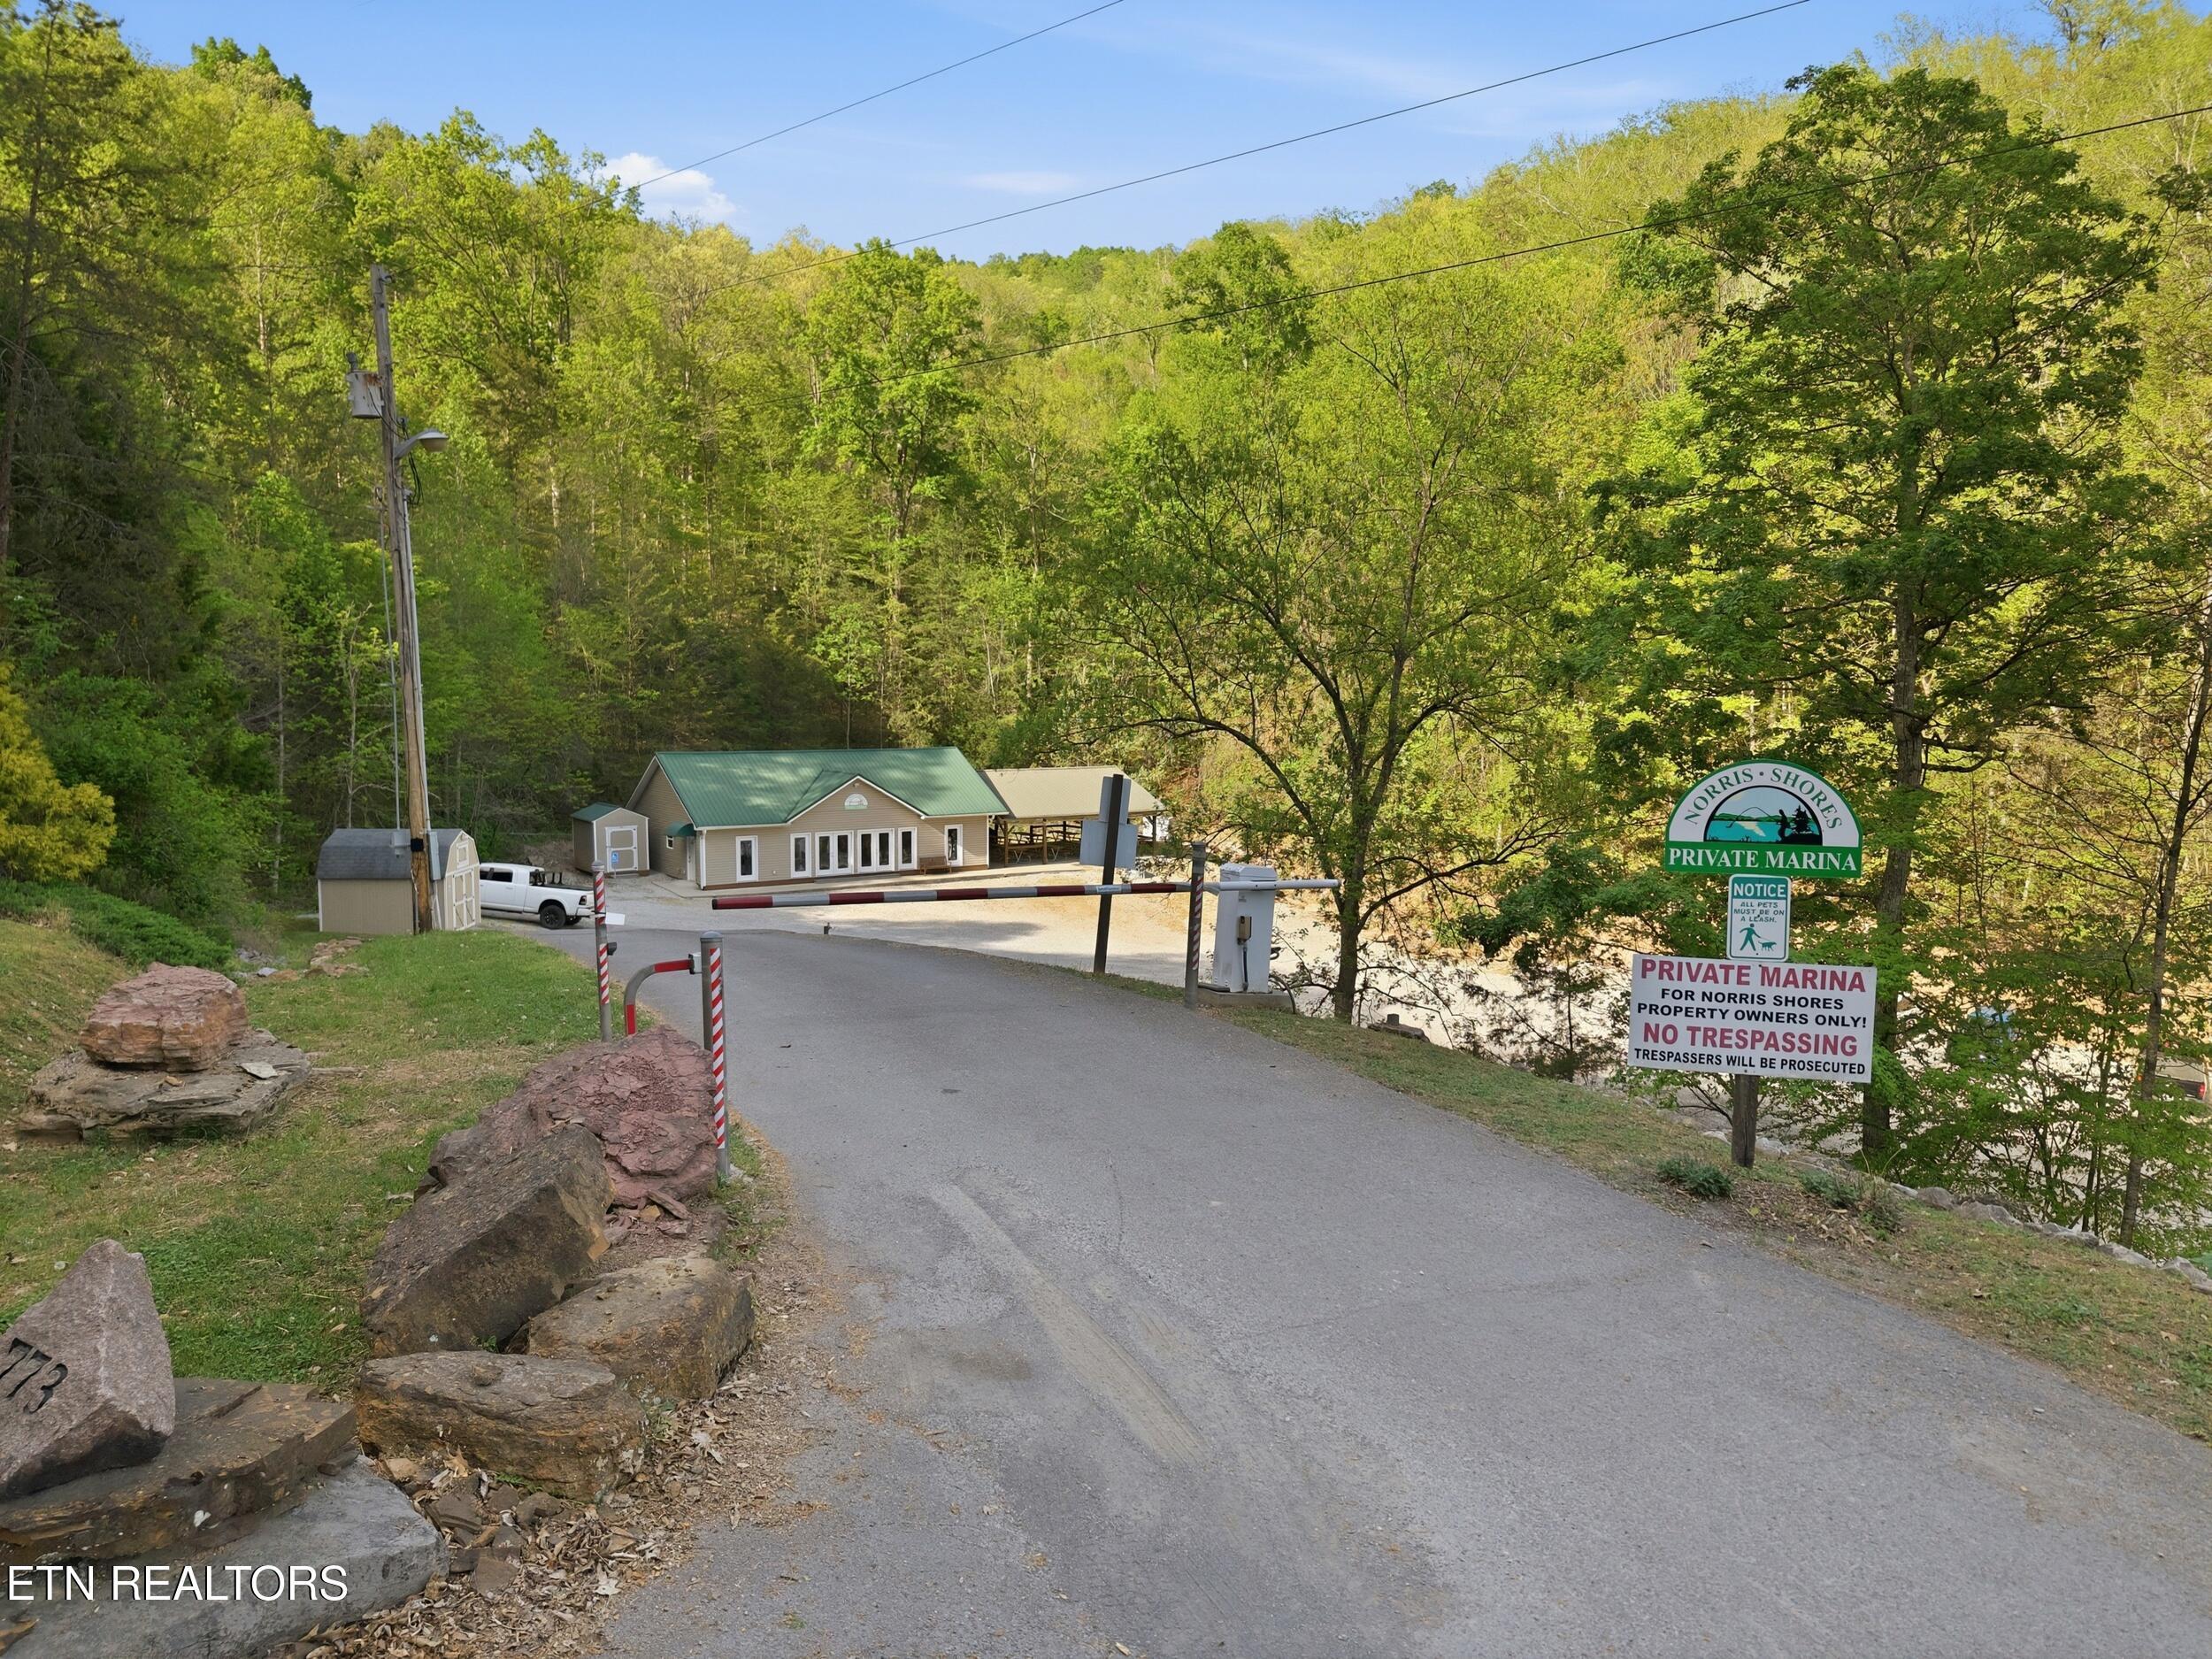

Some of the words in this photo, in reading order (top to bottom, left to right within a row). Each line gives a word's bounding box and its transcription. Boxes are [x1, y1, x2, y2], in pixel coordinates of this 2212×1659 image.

[1684, 767, 1754, 826] NORRIS
[1770, 767, 1842, 829] SHORES
[1669, 848, 1759, 868] PRIVATE
[1765, 850, 1857, 872] MARINA
[1733, 883, 1786, 898] NOTICE
[1641, 958, 1751, 987] PRIVATE
[1760, 965, 1867, 993] MARINA
[1661, 987, 1695, 1002] FOR
[1701, 991, 1767, 1006] NORRIS
[1772, 995, 1844, 1010] SHORES
[1637, 1002, 1730, 1020] PROPERTY
[1734, 1009, 1809, 1025] OWNERS
[1815, 1014, 1867, 1028] ONLY!
[1643, 1022, 1678, 1045] NO
[1686, 1025, 1858, 1057] TRESPASSING
[1634, 1048, 1723, 1066] TRESPASSERS
[1726, 1055, 1755, 1068] WILL
[1760, 1057, 1777, 1069] BE
[1780, 1058, 1865, 1075] PROSECUTED
[0, 1337, 69, 1415] 773
